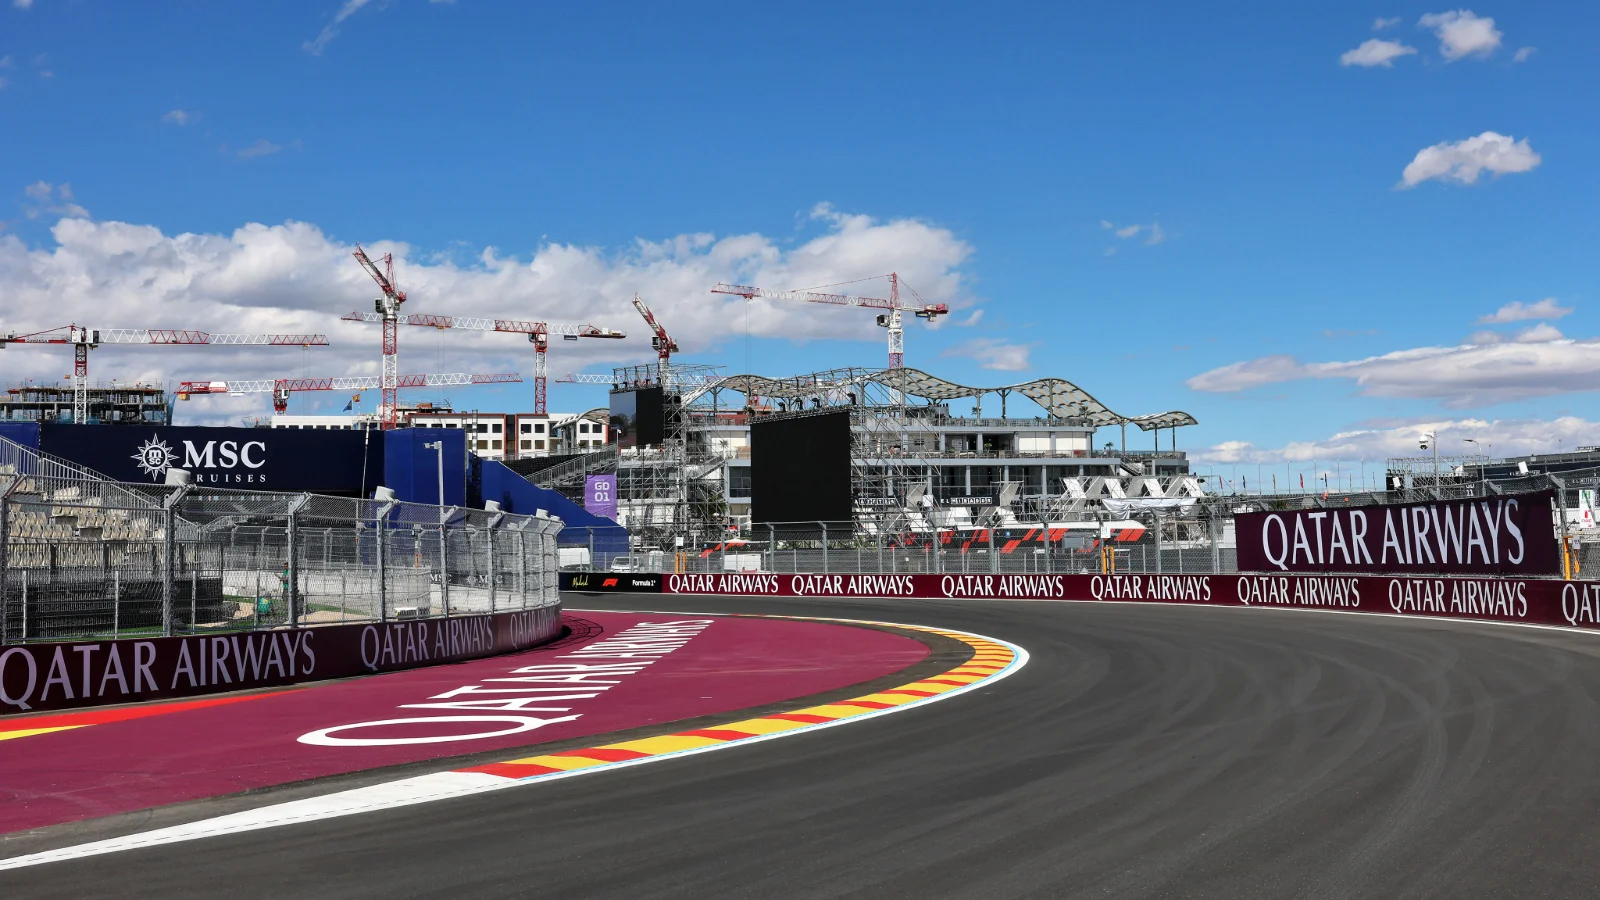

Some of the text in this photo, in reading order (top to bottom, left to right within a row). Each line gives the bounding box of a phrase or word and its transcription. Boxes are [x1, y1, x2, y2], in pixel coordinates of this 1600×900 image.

[182, 440, 266, 468] MSC
[196, 474, 266, 483] RUISES
[1262, 498, 1525, 571] QATAR AIRWAYS
[669, 575, 779, 593] QATAR AIRWAYS
[792, 575, 914, 595] QATAR AIRWAYS
[941, 576, 1064, 598] QATAR AIRWAYS
[1090, 576, 1211, 601] QATAR AIRWAYS
[1237, 576, 1360, 608] QATAR AIRWAYS
[1388, 579, 1528, 618] QATAR AIRWAYS
[361, 615, 494, 671] QATAR AIRWAYS
[0, 631, 316, 710] QATAR AIRWAYS
[296, 660, 656, 747] QATAR
